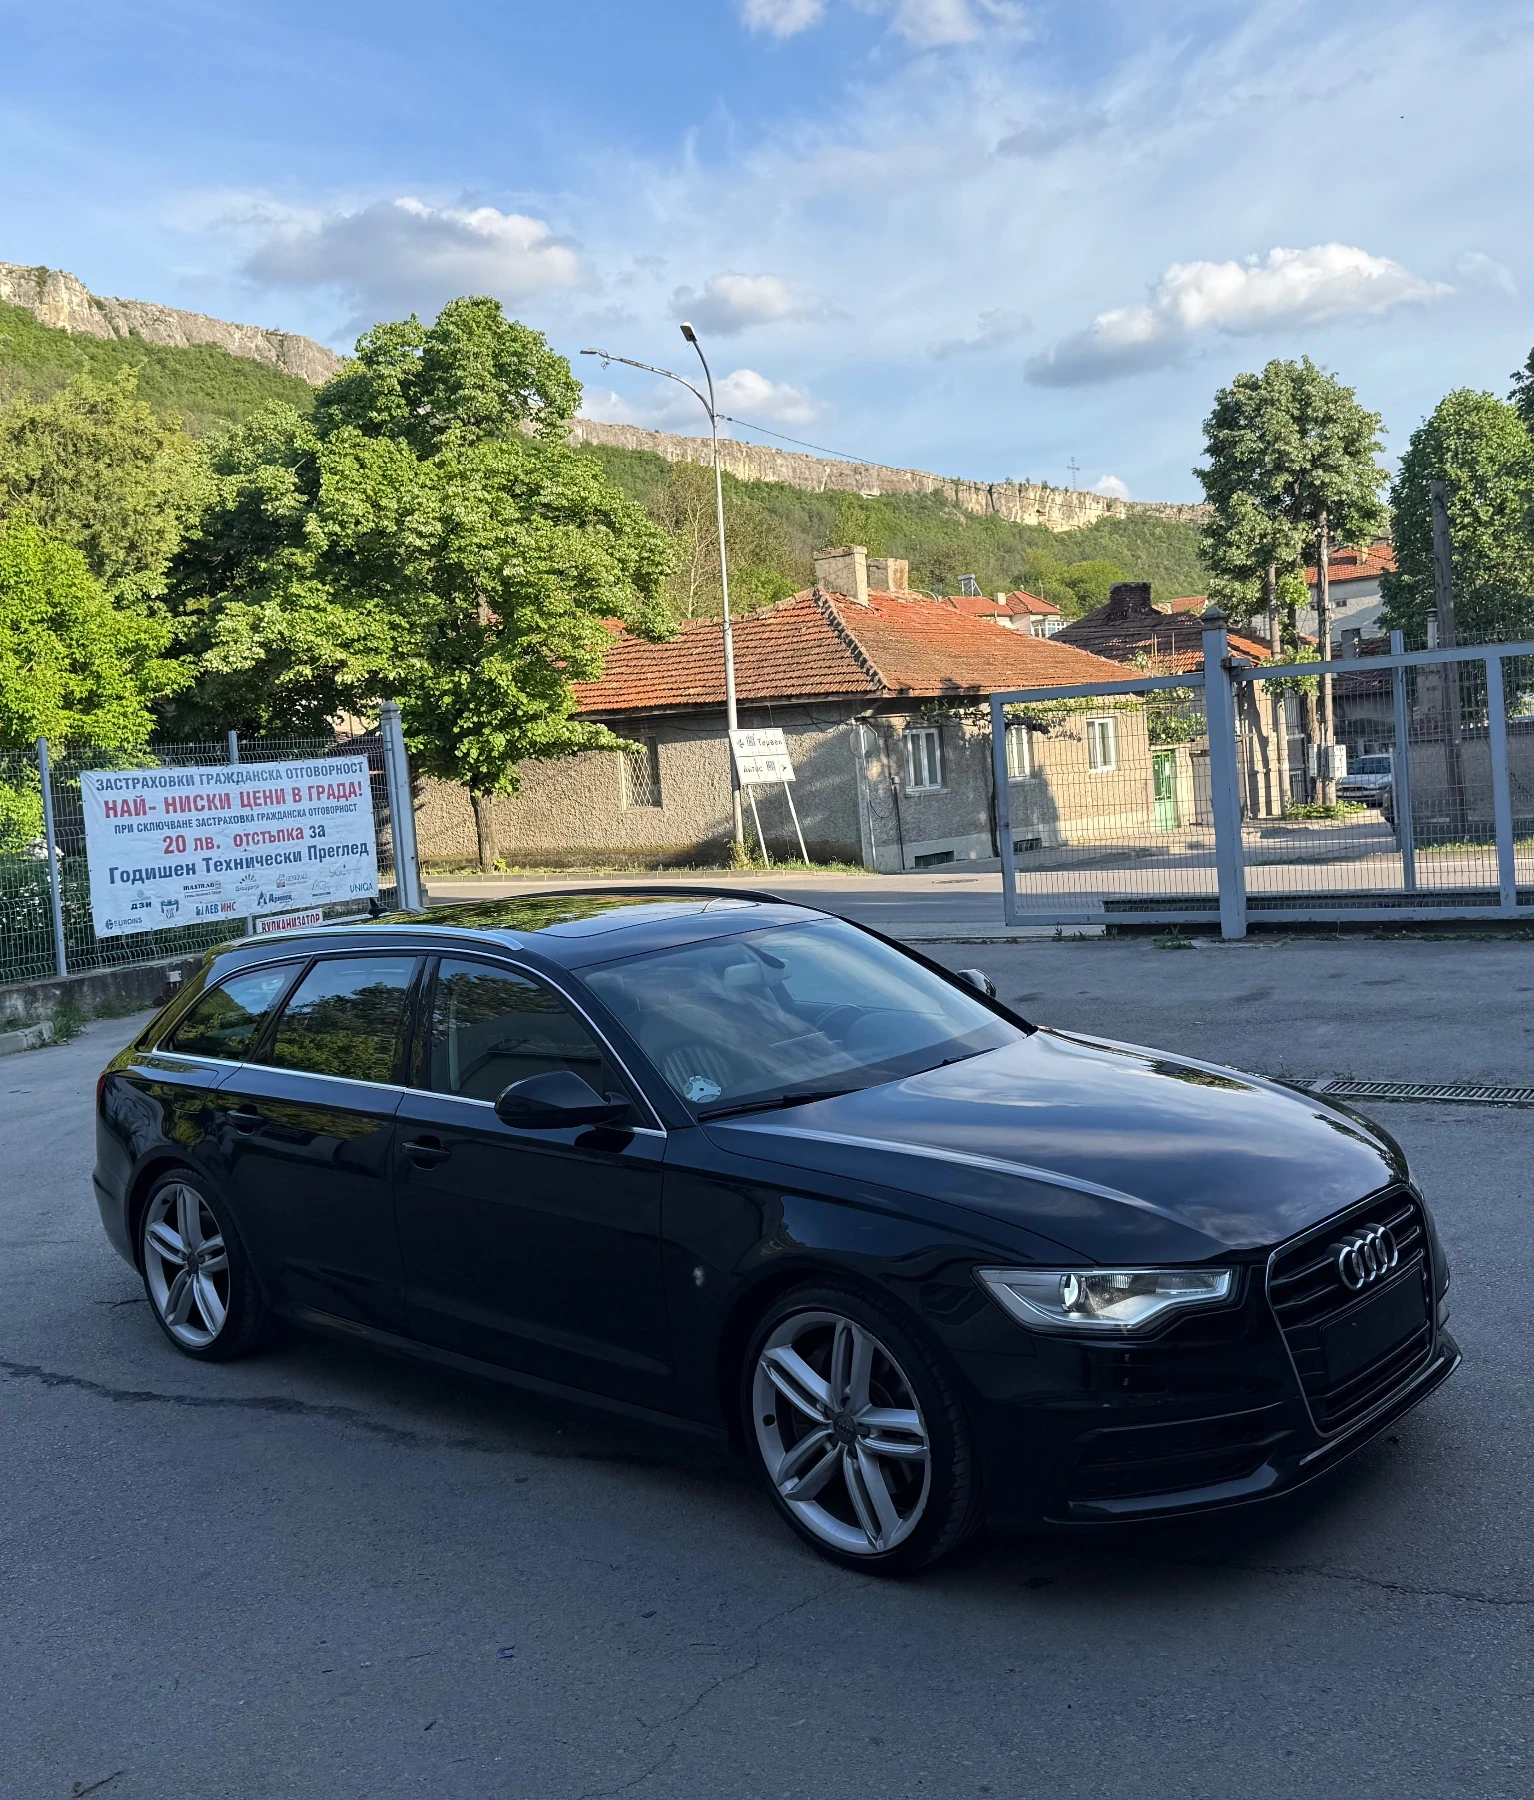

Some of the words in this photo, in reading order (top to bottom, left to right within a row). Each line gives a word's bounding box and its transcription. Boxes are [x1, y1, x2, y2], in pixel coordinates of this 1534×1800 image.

[96, 774, 195, 791] ЗАСТРАХОВКИ
[199, 769, 283, 785] ГРАЖДАНСКА
[285, 762, 364, 779] ОТГОВОРНОСТ
[104, 795, 157, 818] НАЙ-
[163, 792, 232, 815] НИСКИ
[239, 788, 287, 811] ЦЕНИ
[291, 787, 303, 804] В
[308, 781, 363, 802] ГРАДА!
[114, 824, 134, 834] ПРИ
[137, 820, 193, 833] СКЛЮЧВАНЕ
[195, 814, 255, 828] ЗАСТРАХОВКА
[257, 808, 307, 822] ГРАЖДАНСКА
[308, 803, 358, 817] ОТГОВОРНОСТ
[163, 834, 187, 854] 20
[193, 836, 221, 851] лв.
[233, 826, 304, 848] отстъпка
[309, 824, 326, 839] за
[109, 862, 196, 885] Годишен
[202, 850, 302, 874] Технически
[307, 842, 369, 863] Преглед
[349, 882, 373, 893] UNIQA
[113, 916, 143, 927] EUROINS
[205, 904, 219, 915] ЛЕВ
[220, 901, 236, 912] ИНС
[261, 913, 320, 933] ВУЛКАНИЗАТОР
